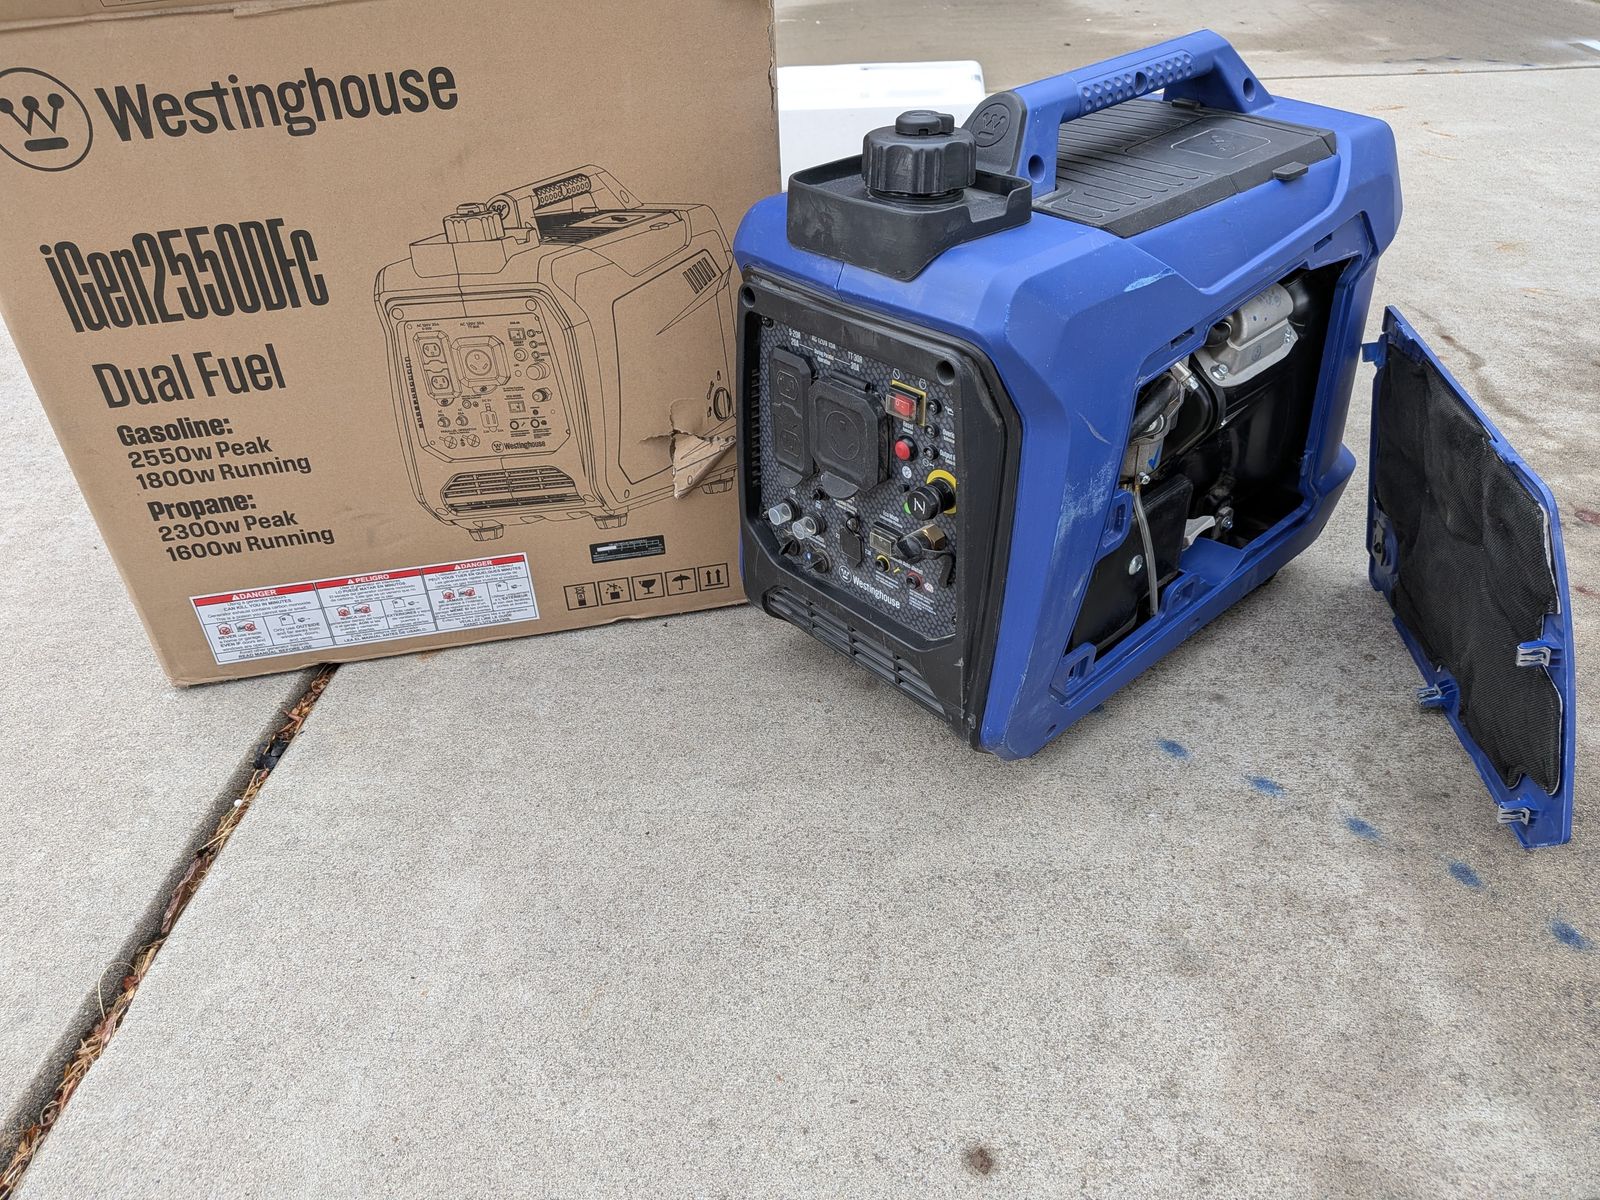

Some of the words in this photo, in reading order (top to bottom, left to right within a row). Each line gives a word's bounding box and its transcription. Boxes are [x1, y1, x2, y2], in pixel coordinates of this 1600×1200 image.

[95, 65, 458, 137] Westinghouse
[40, 218, 329, 333] iGen2550DFc
[92, 354, 195, 409] Dual
[193, 343, 286, 397] Fuel
[117, 416, 233, 447] Gasoline:
[128, 446, 212, 469] 2550w
[215, 436, 273, 458] Peak
[136, 468, 215, 490] 1800w
[218, 456, 312, 482] Running
[147, 493, 257, 522] Propane:
[158, 520, 240, 542] 2300w
[243, 510, 298, 531] Peak
[166, 540, 242, 562] 1600w
[245, 527, 335, 552] Running
[355, 574, 390, 583] PELIGRO
[461, 561, 493, 569] DANGER
[239, 590, 277, 600] DANGER
[852, 575, 900, 609] Westinghouse
